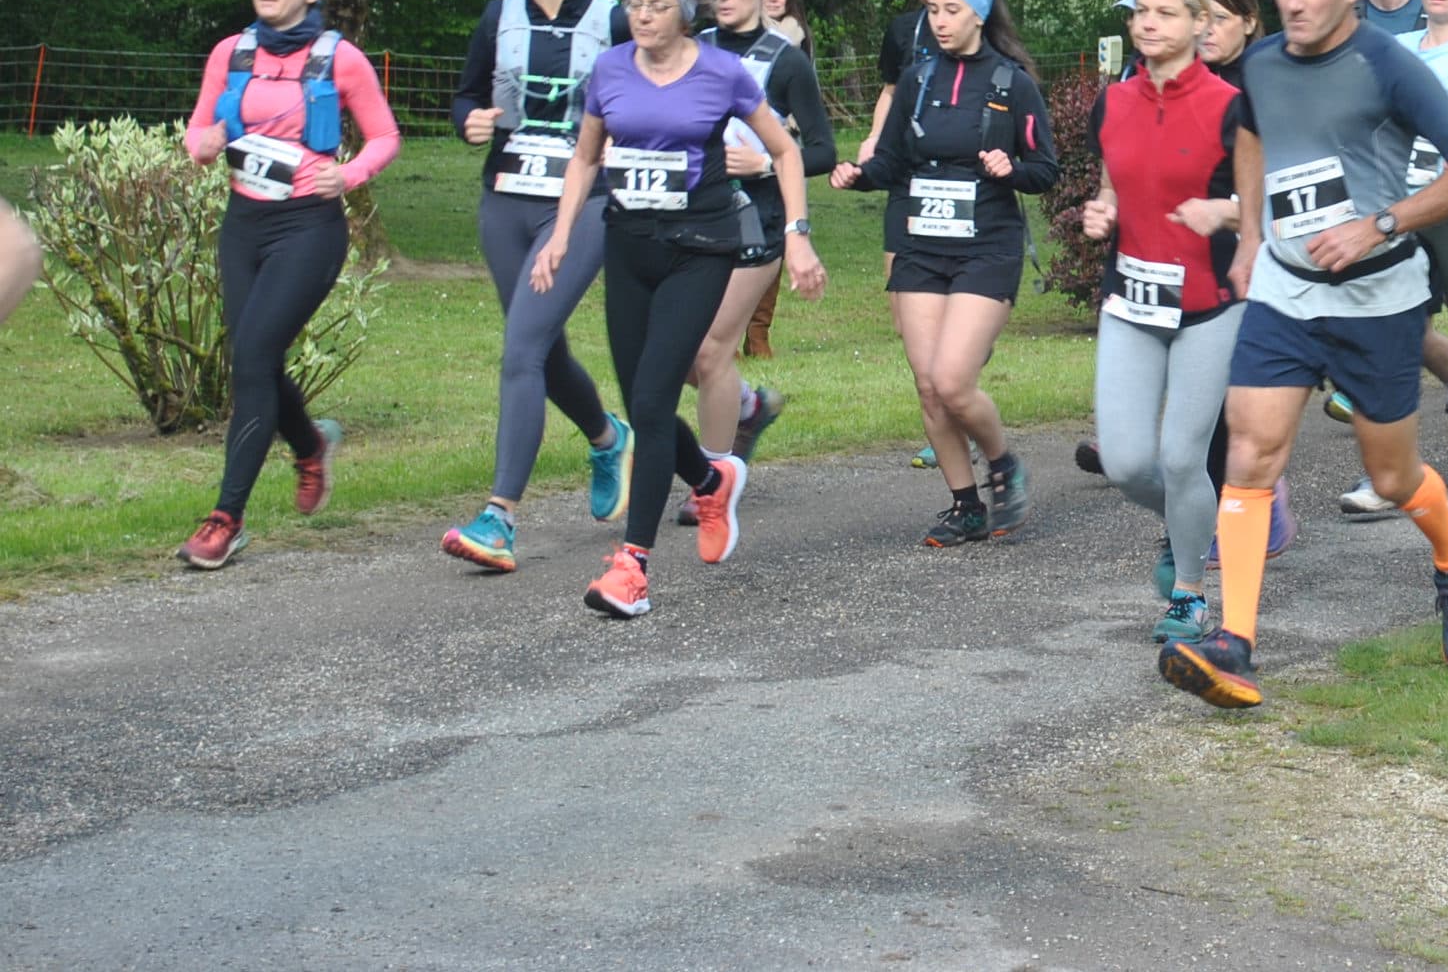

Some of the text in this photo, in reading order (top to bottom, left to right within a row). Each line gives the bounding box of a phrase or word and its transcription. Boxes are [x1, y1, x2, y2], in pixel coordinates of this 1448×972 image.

[243, 154, 273, 177] 67
[518, 155, 548, 177] 78
[624, 168, 668, 192] 112
[920, 198, 956, 219] 226
[1287, 186, 1317, 215] 17
[1123, 278, 1159, 306] 111
